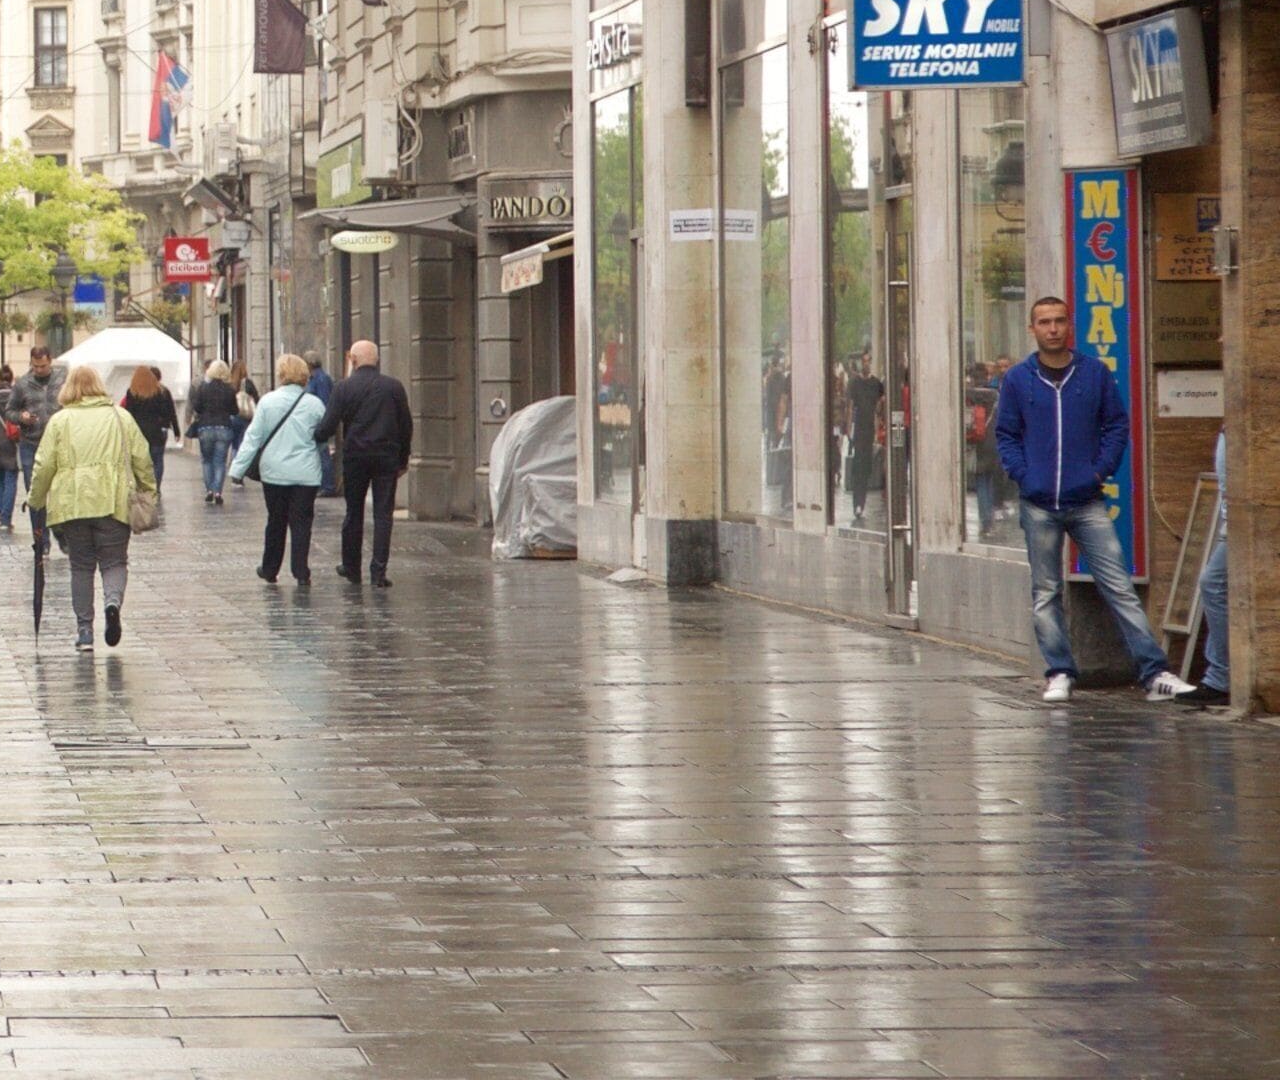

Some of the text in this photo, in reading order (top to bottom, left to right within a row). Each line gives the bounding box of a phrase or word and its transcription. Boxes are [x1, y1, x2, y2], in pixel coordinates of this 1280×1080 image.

[985, 17, 1021, 33] MOBILE
[861, 42, 1018, 61] SERVIS MOBILNIH
[889, 60, 980, 78] TELEFONA
[1128, 28, 1162, 104] SKY
[490, 192, 573, 220] PANDO
[1198, 203, 1220, 219] SK
[339, 234, 383, 246] swatch
[170, 264, 206, 272] ciciban
